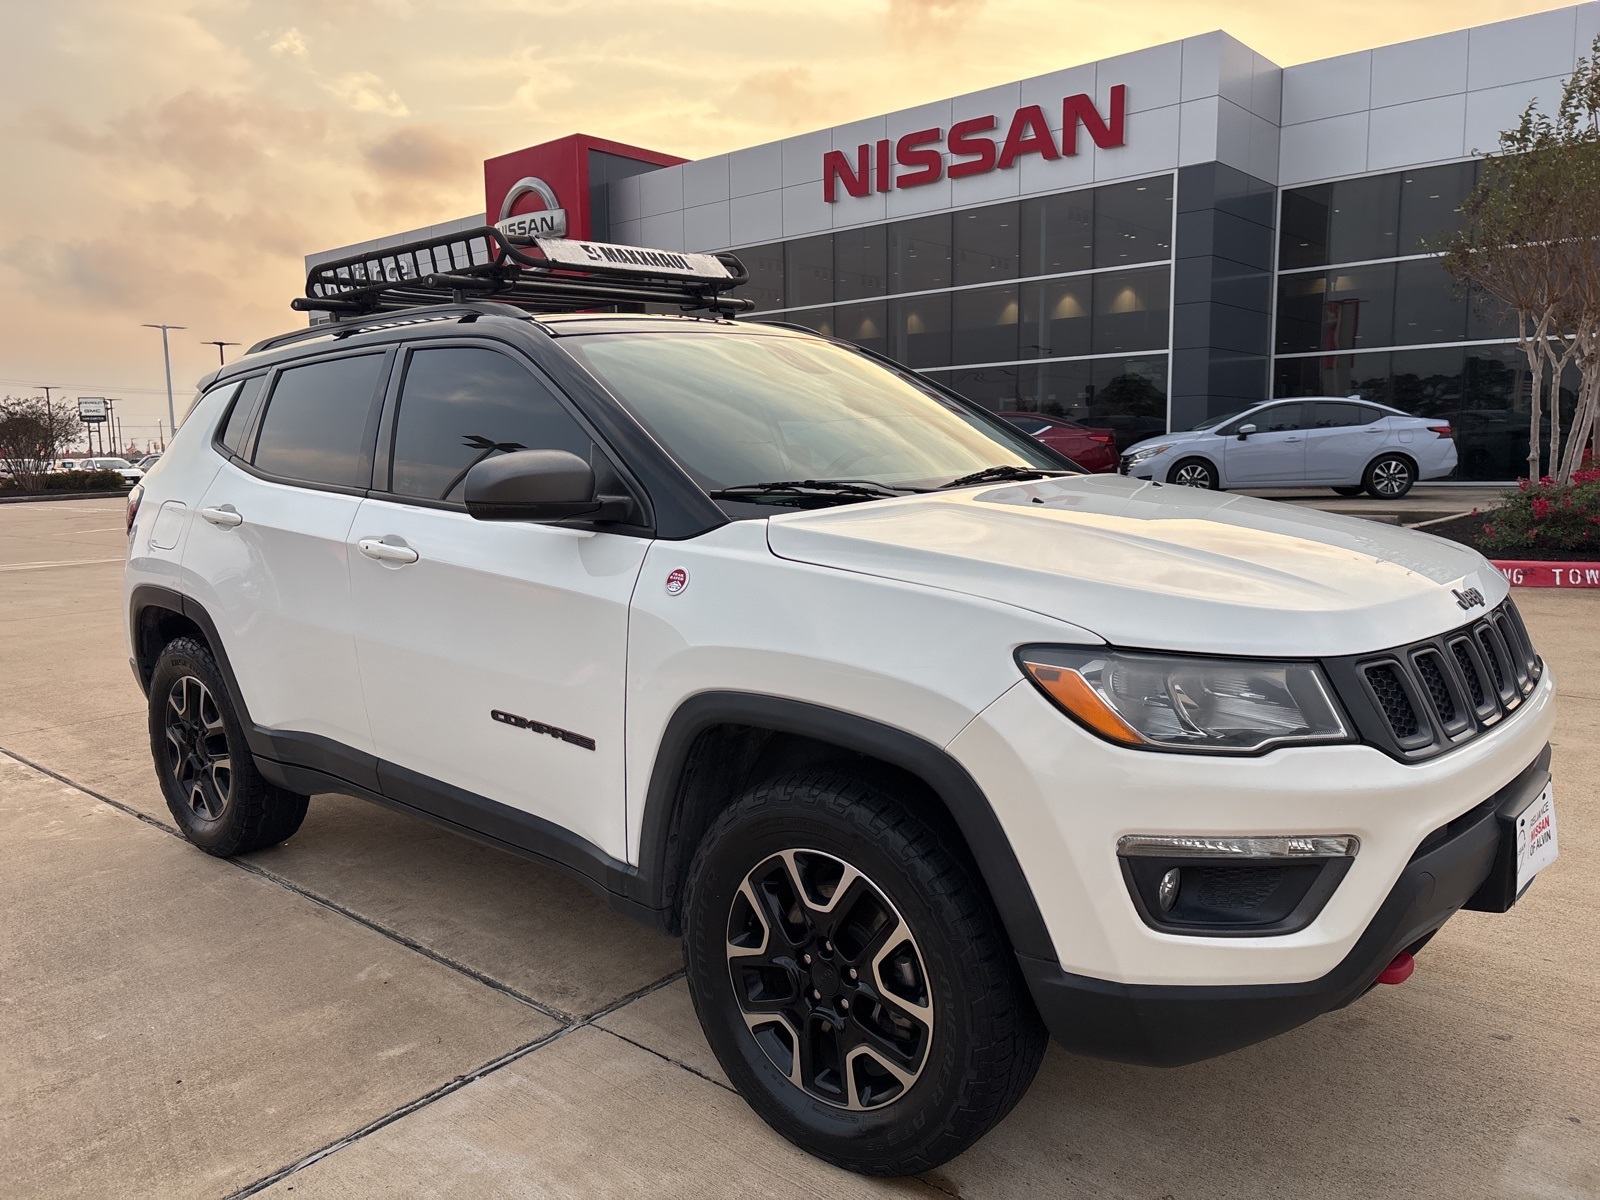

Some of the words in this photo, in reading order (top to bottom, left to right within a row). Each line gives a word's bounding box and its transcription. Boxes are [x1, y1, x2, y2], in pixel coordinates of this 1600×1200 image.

[824, 84, 1126, 203] NISSAN
[598, 247, 694, 270] MAXXHAUL
[1551, 568, 1600, 586] TOW
[1451, 587, 1486, 610] Jeep
[490, 709, 596, 751] COMPASS
[1531, 815, 1550, 842] NISSAN
[1530, 841, 1537, 857] OF
[1536, 830, 1551, 850] ALVIN
